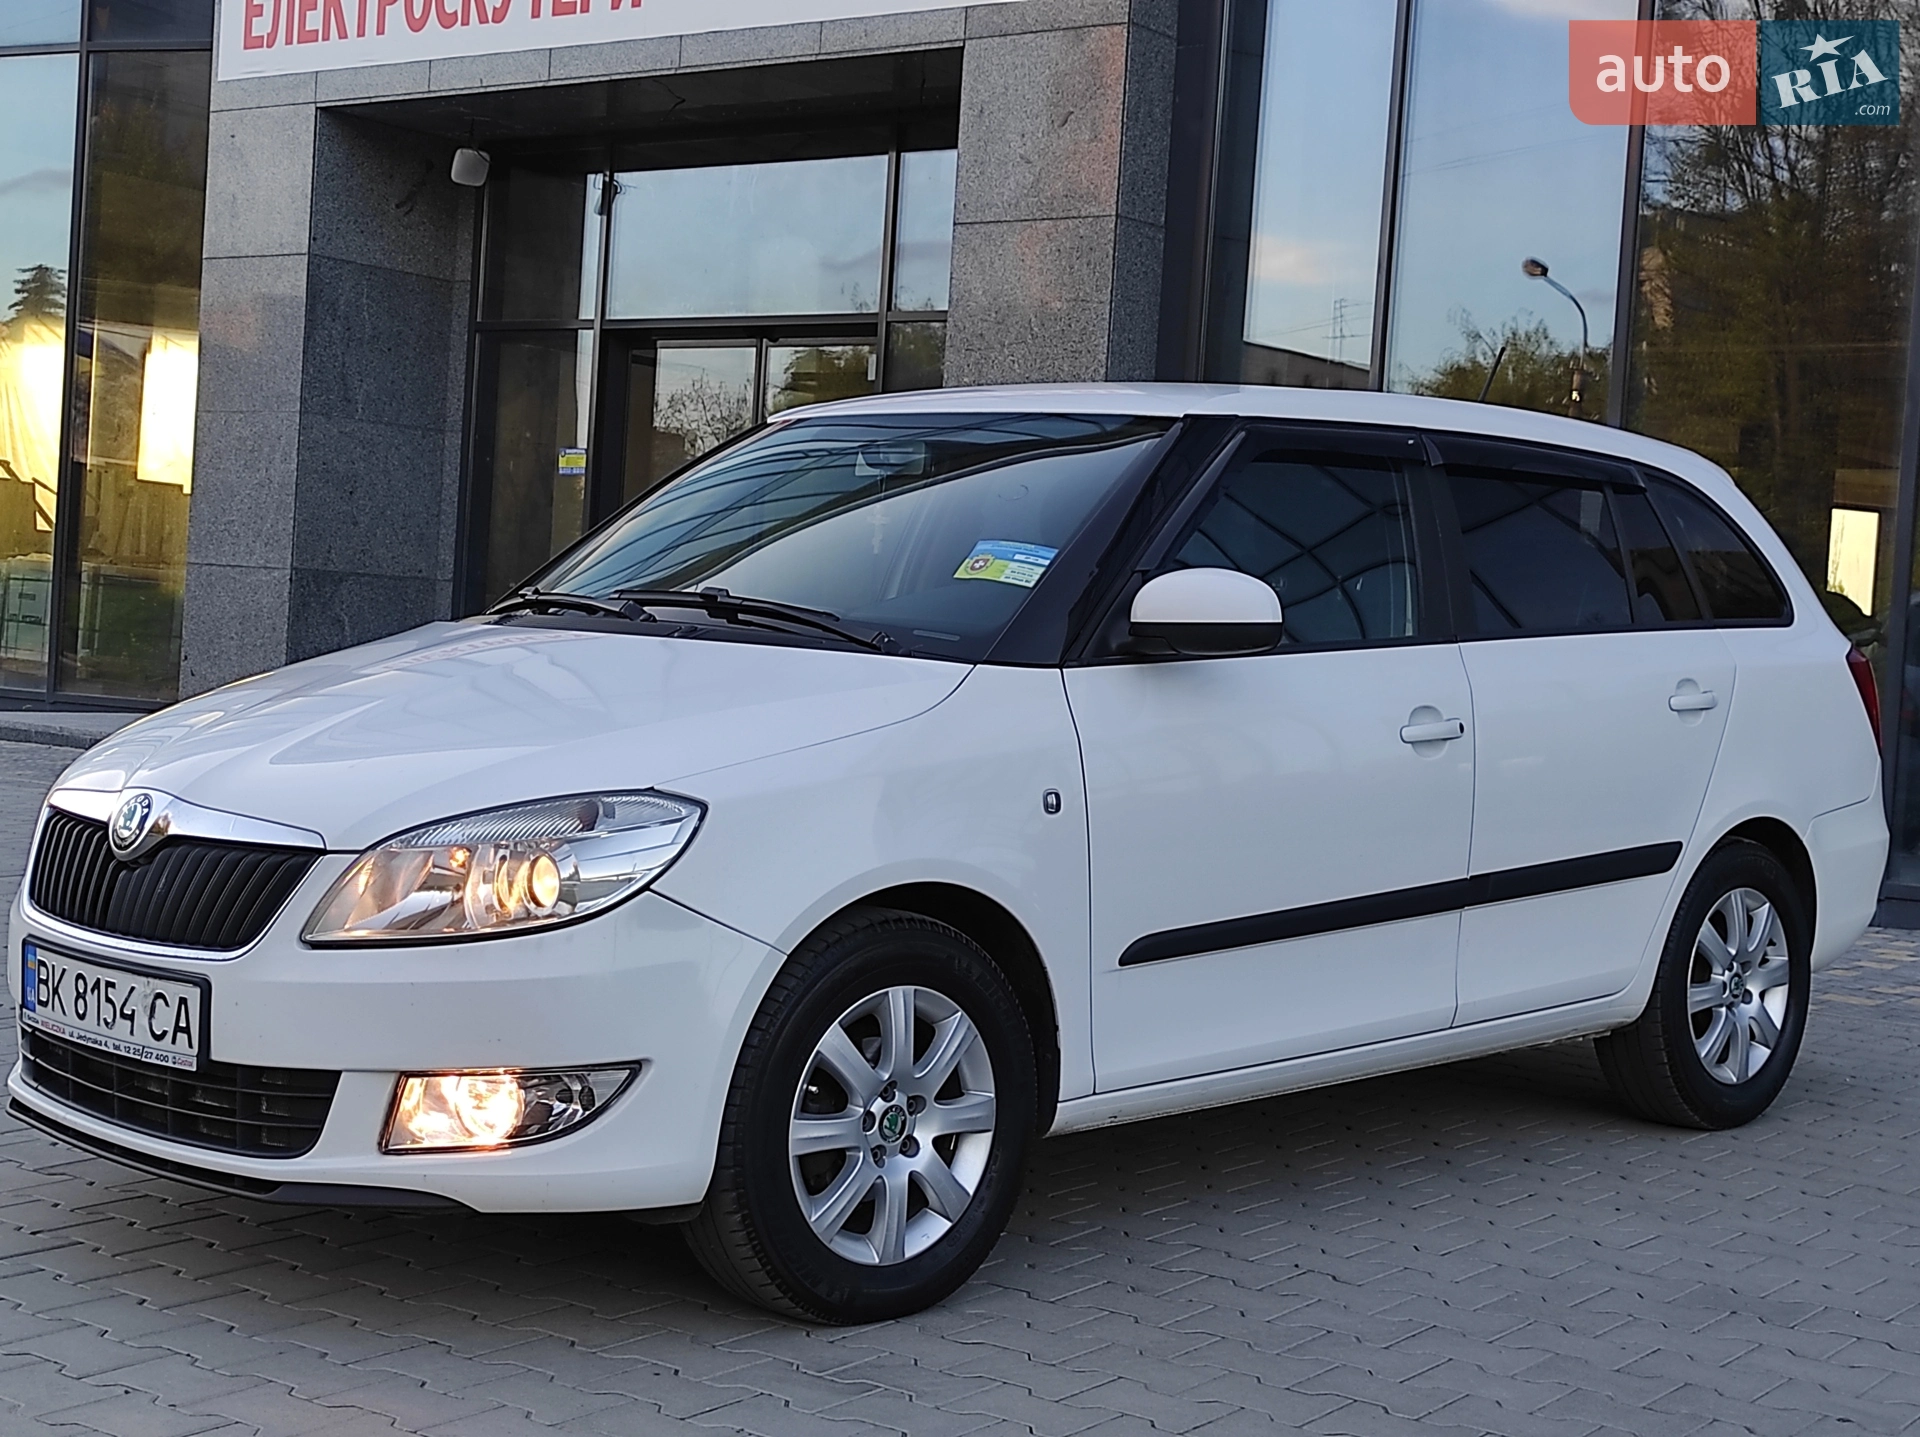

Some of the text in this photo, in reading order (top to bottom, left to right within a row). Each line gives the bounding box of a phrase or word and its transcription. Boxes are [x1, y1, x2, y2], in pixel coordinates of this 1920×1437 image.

[243, 0, 642, 50] ЕЛЕКТРО
[37, 958, 194, 1049] BK 8154 CA
[144, 1050, 153, 1060] 27
[155, 1052, 169, 1064] 400
